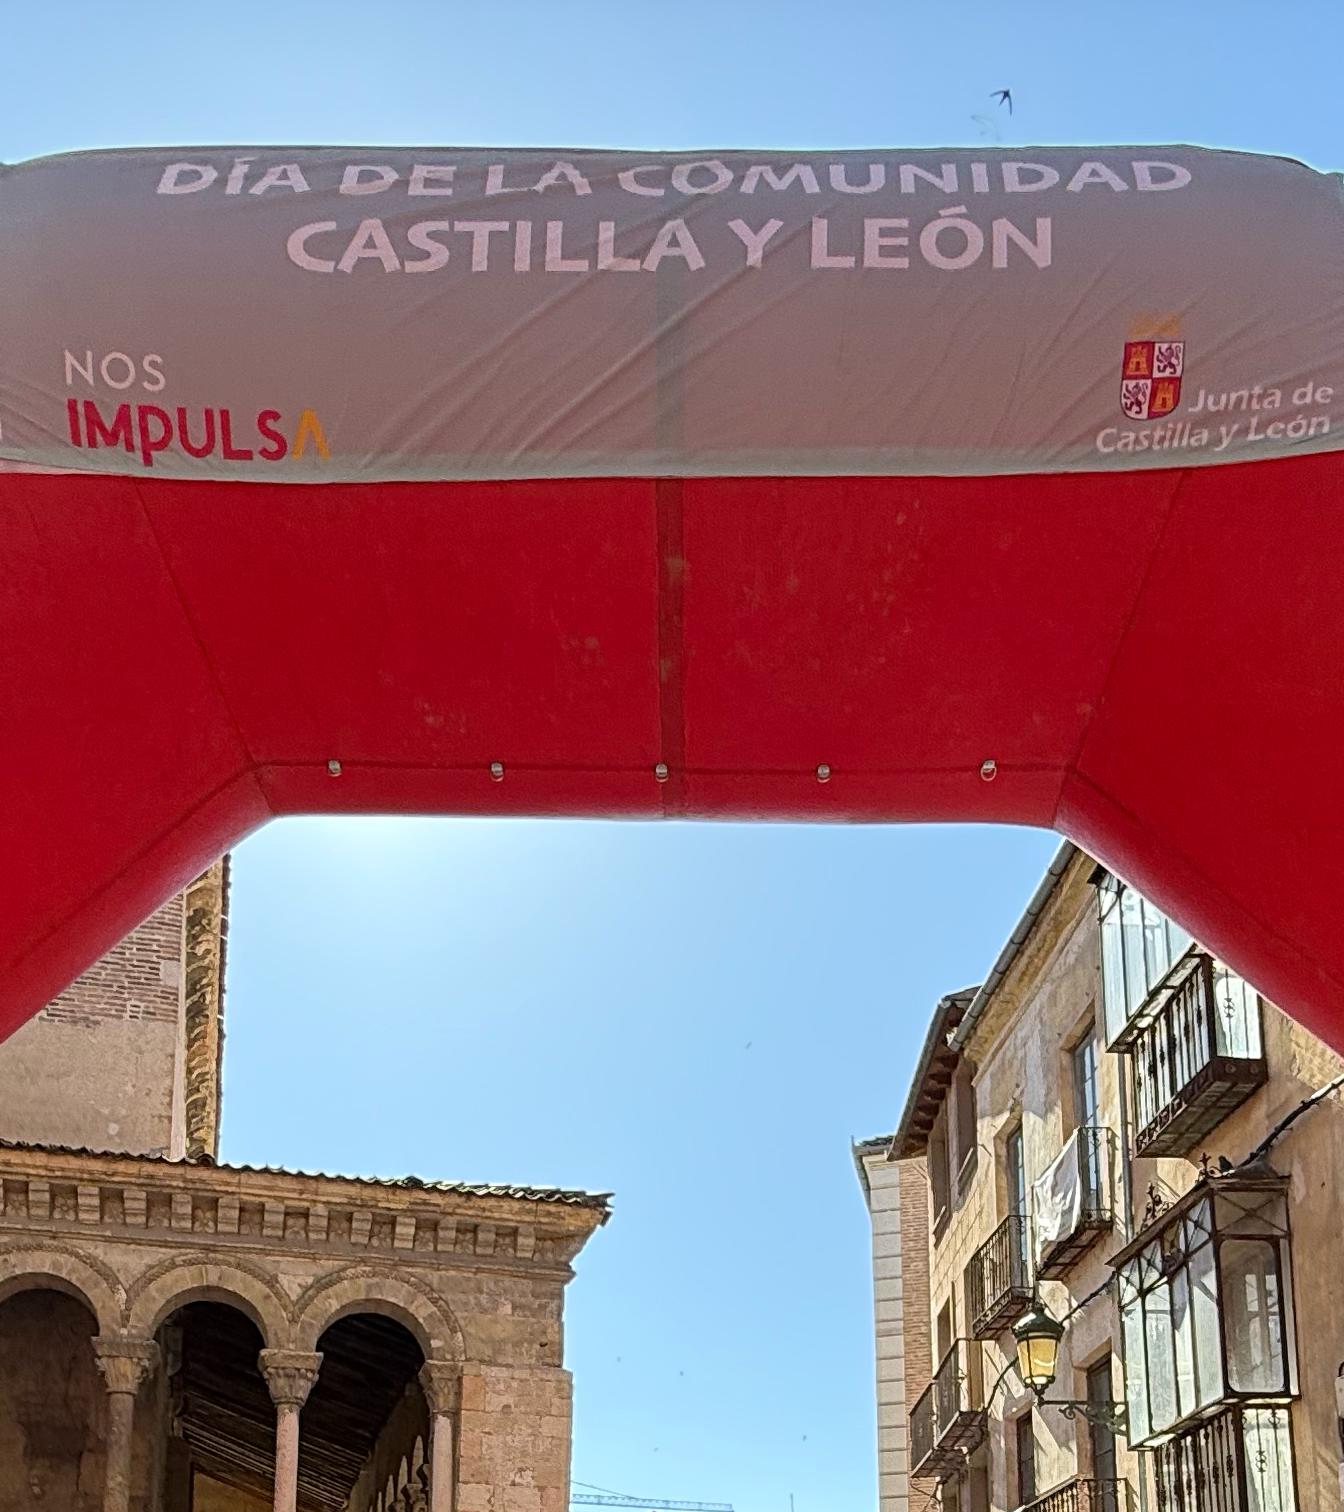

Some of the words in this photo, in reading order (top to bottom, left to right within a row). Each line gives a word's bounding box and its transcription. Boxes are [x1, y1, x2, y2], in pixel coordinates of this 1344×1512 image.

[156, 157, 312, 195] DÍA
[339, 163, 454, 196] DE
[484, 160, 593, 196] LA
[617, 159, 1193, 196] COMUNIDAD
[286, 217, 707, 273] CASTILLA
[727, 217, 784, 269] Y
[810, 204, 1053, 270] LEÓN
[63, 347, 166, 392] NOS
[1188, 385, 1282, 413] Junta
[1291, 381, 1335, 405] de
[66, 397, 332, 467] IMPULSA
[1095, 421, 1209, 454] Castilla
[1213, 423, 1239, 451] y
[1246, 413, 1332, 442] León
